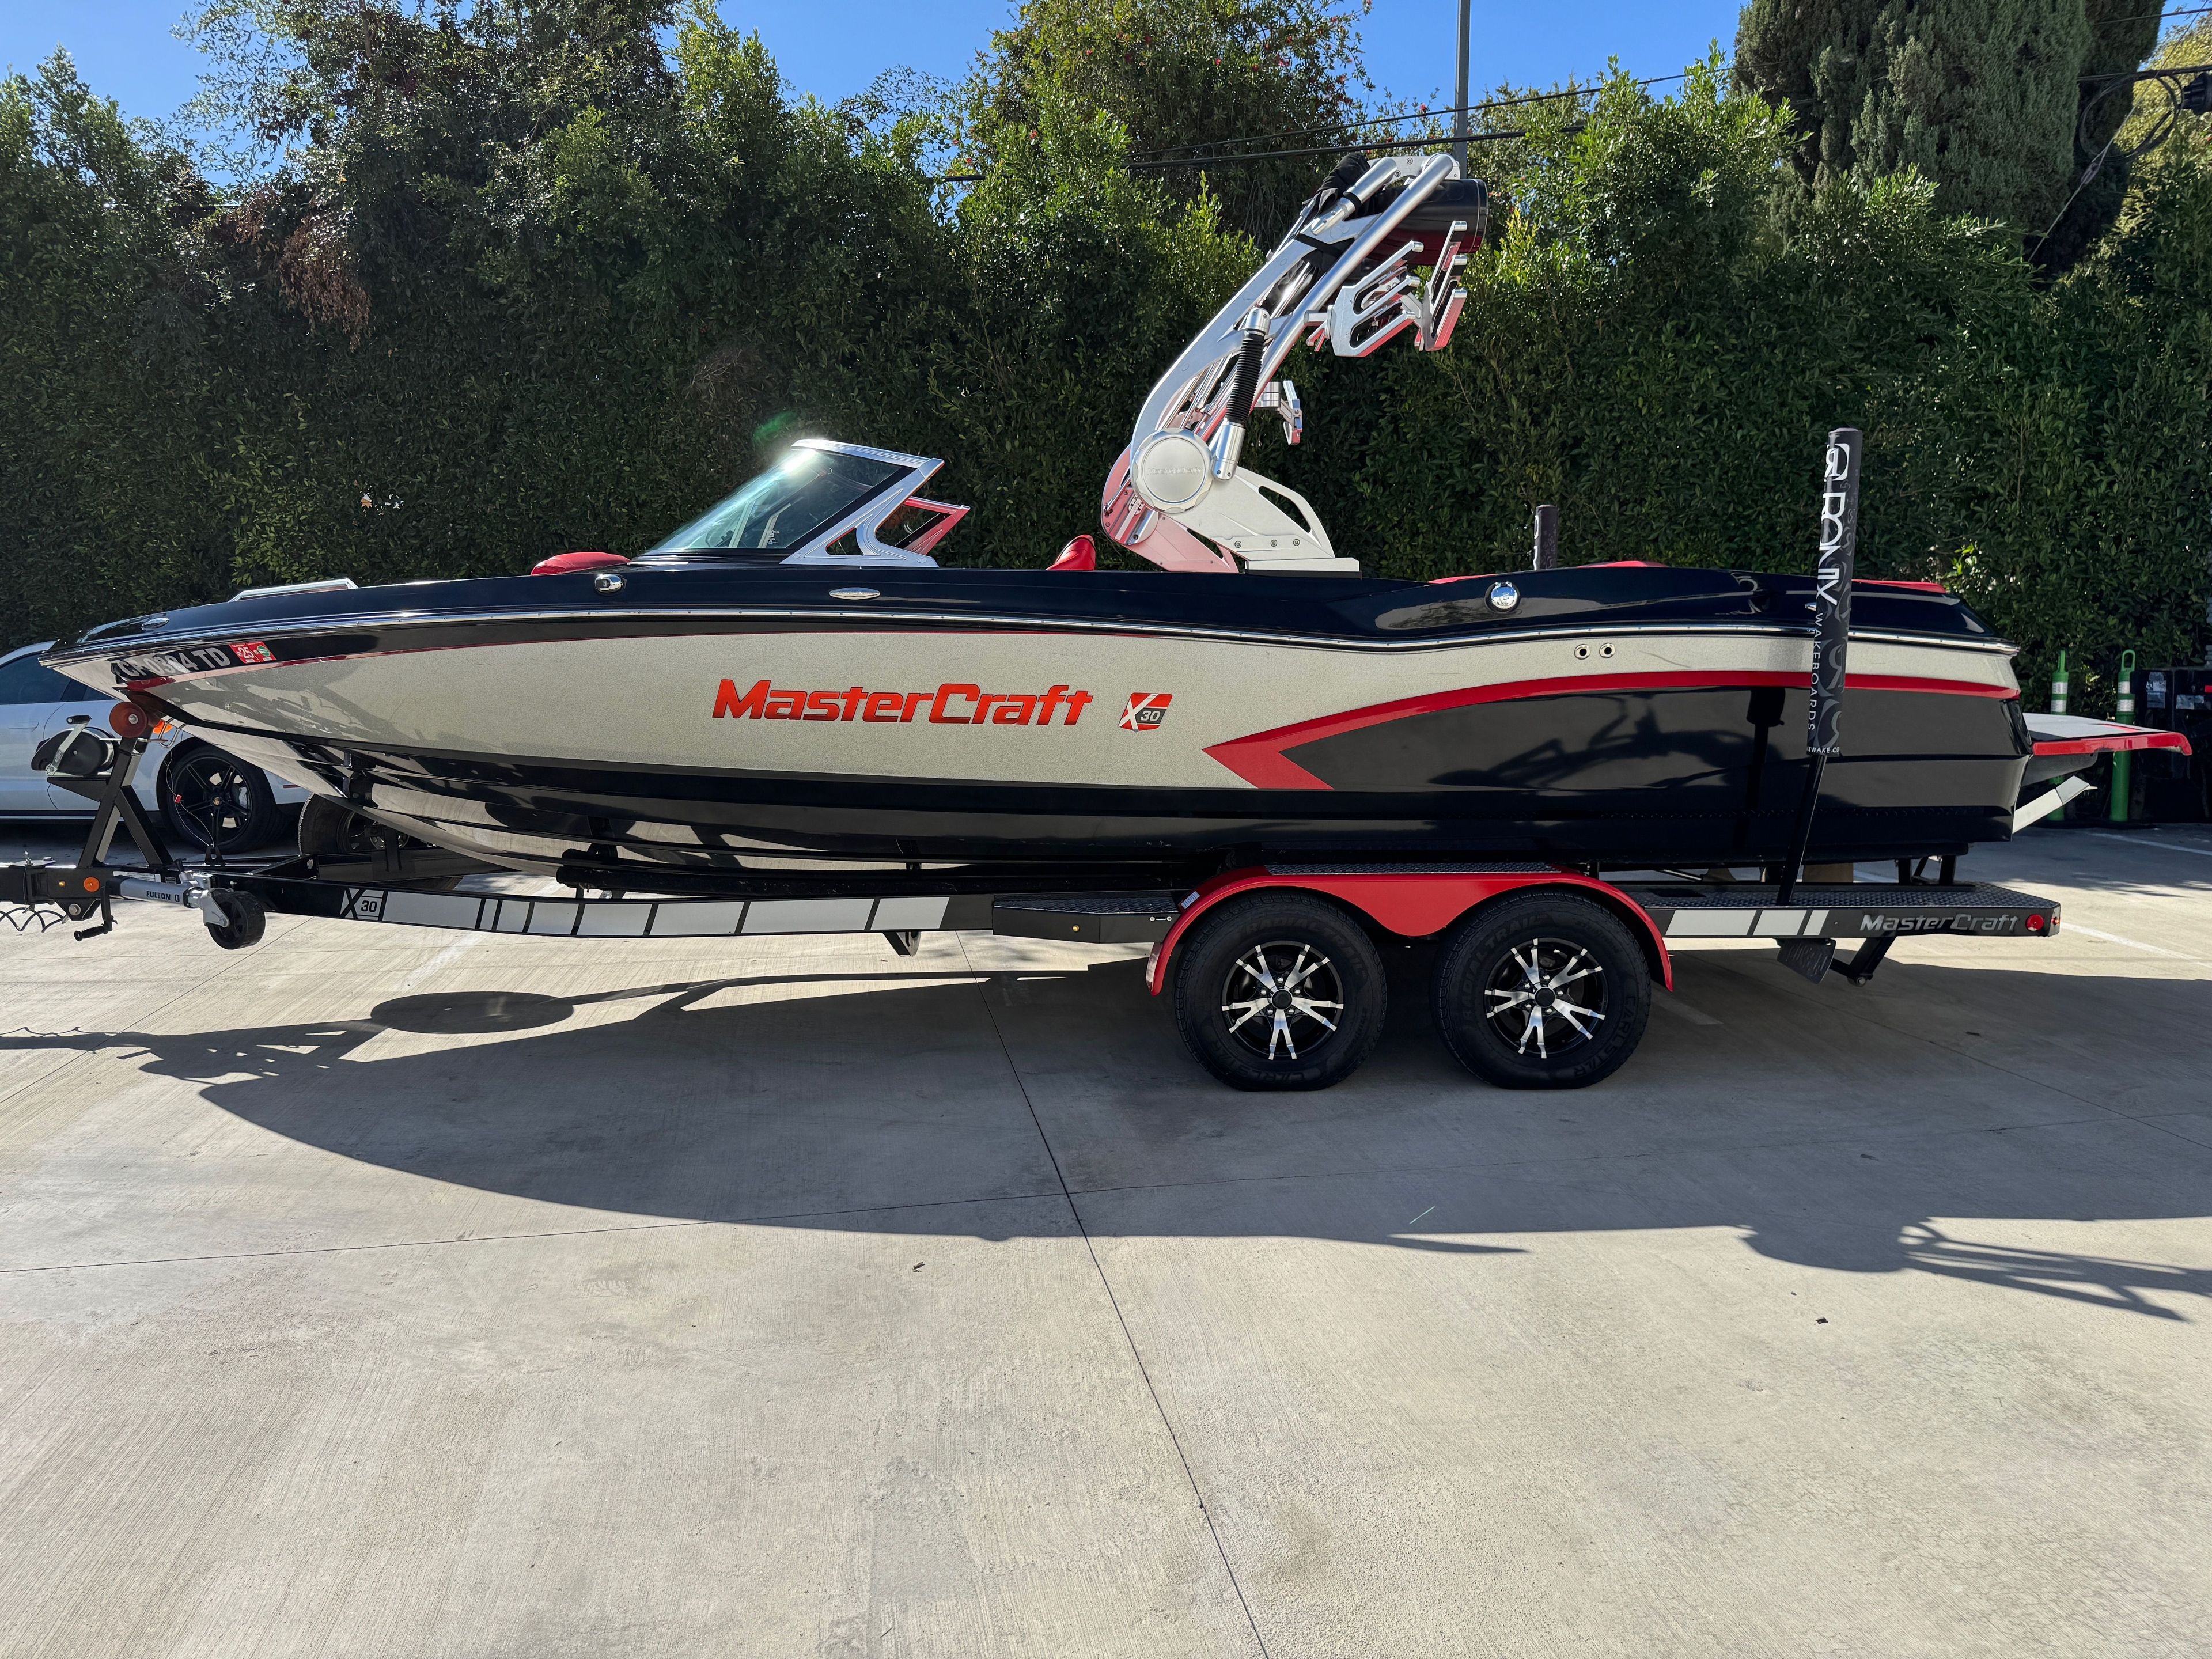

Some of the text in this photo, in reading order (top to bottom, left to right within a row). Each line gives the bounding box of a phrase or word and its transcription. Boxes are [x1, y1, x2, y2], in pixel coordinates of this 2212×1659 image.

[191, 647, 230, 668] TD
[238, 647, 254, 658] 25
[1808, 613, 1824, 730] WAKEBOARDS
[712, 679, 1093, 725] MasterCraft
[146, 891, 171, 900] FULTON
[1859, 914, 2020, 931] MasterCraft
